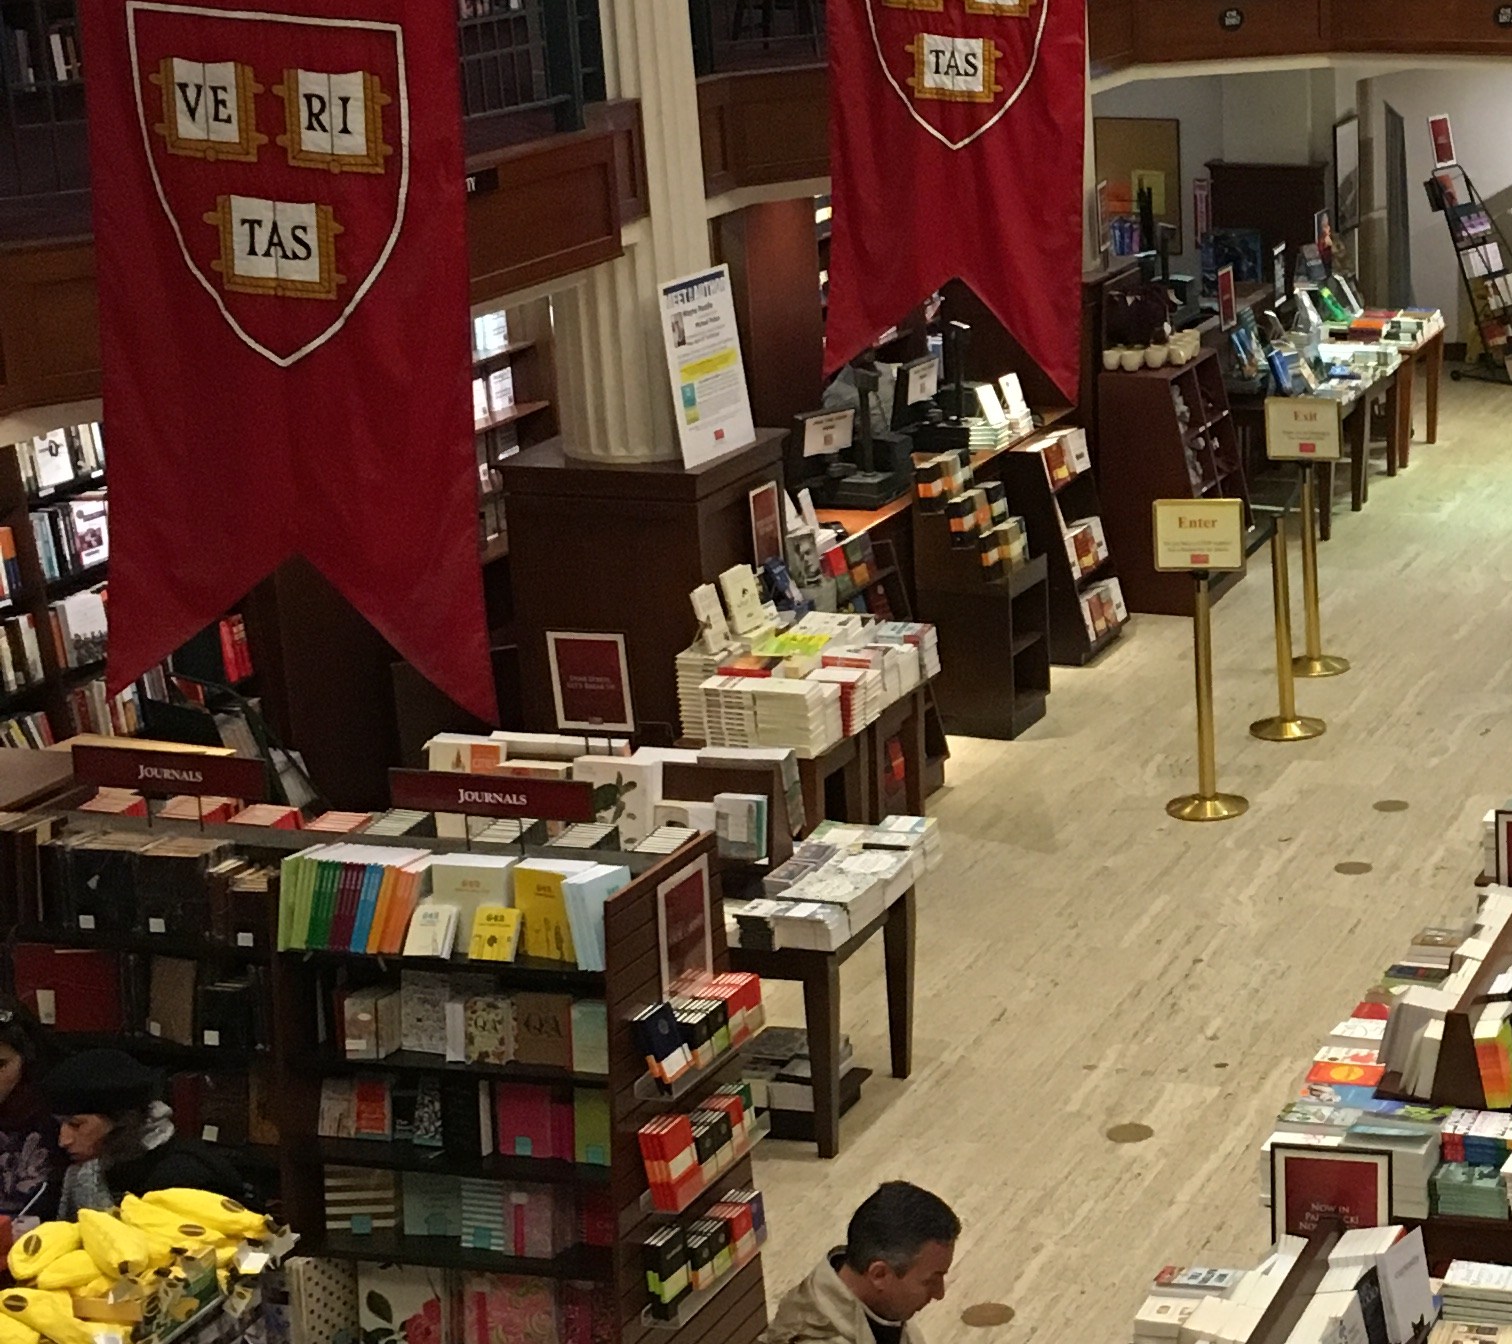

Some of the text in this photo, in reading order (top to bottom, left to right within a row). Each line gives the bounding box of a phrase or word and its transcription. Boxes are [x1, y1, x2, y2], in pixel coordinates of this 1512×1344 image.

[930, 47, 978, 77] TAS
[176, 82, 352, 134] VE RI
[241, 218, 312, 261] TAS
[1293, 410, 1317, 422] Exit
[1178, 516, 1218, 529] Enter
[1311, 1202, 1337, 1212] NOW
